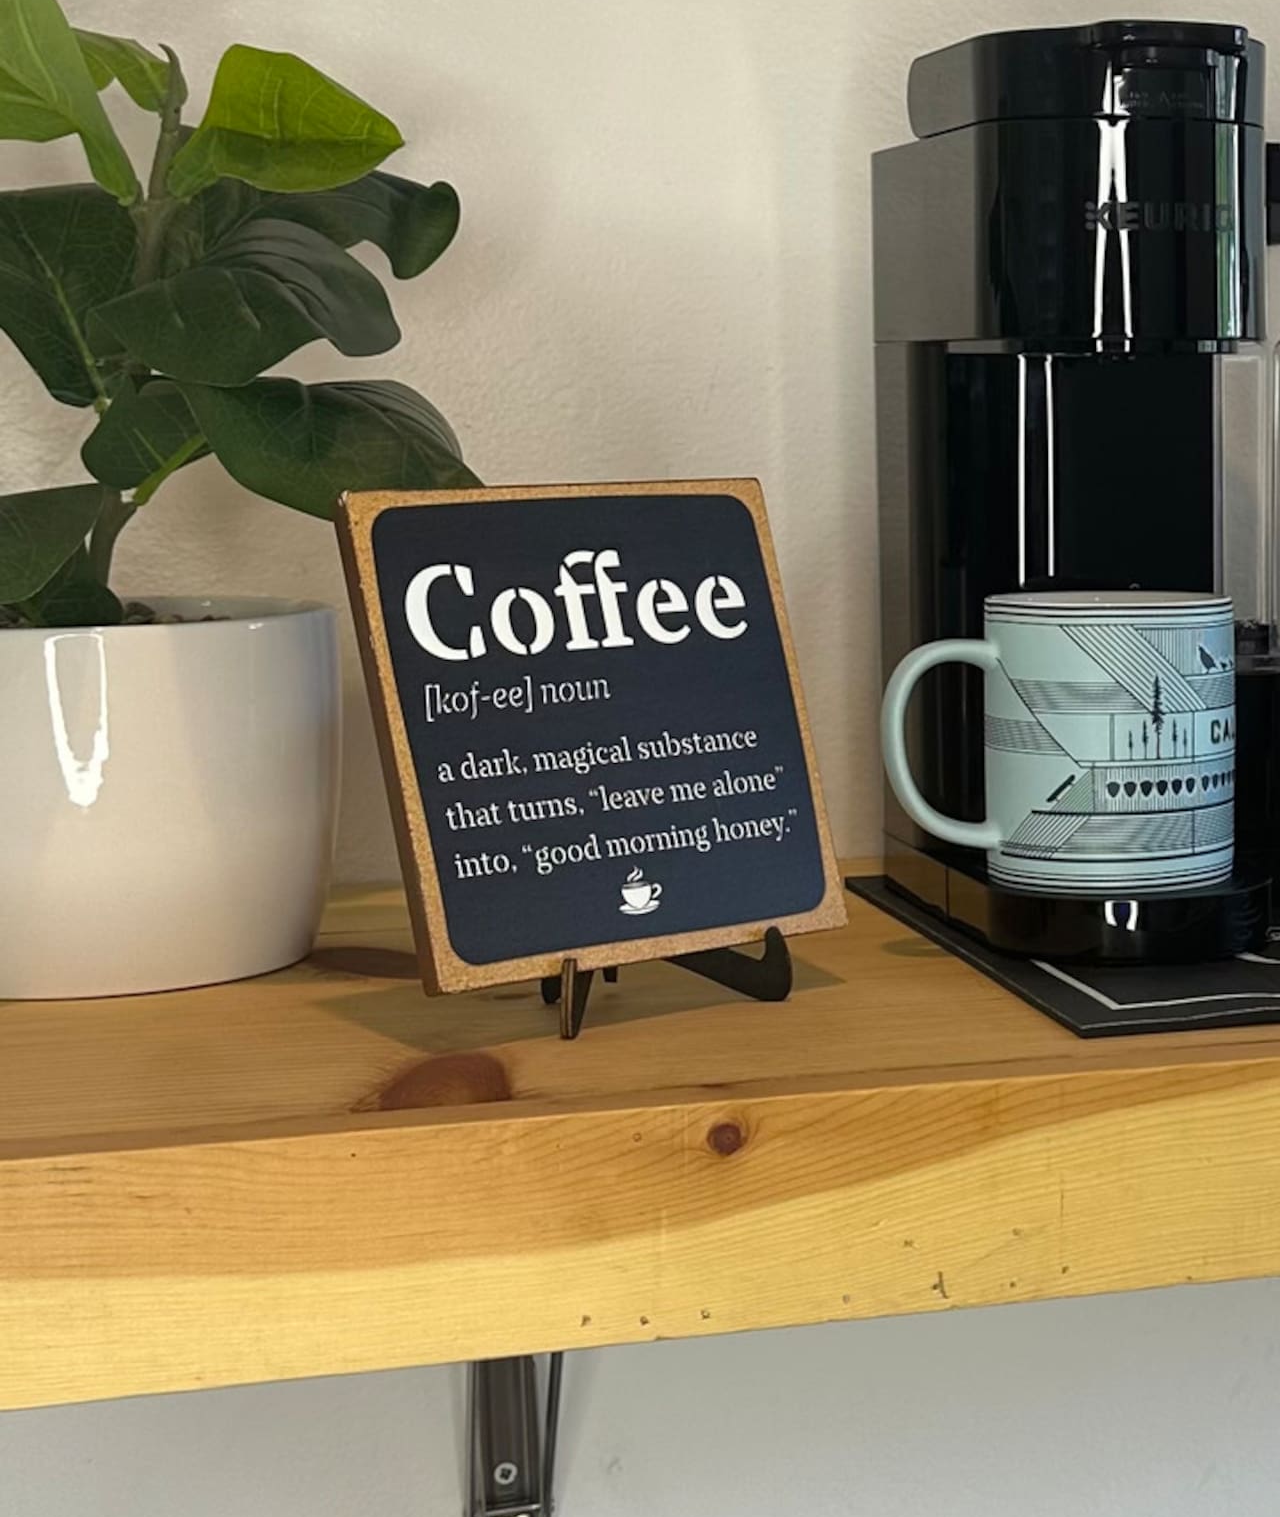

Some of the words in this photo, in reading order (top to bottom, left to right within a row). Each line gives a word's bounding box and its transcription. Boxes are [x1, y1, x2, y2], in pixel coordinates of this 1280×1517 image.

[1084, 201, 1233, 233] KEURIG
[405, 549, 748, 661] Coffee
[425, 675, 533, 722] [kof-ee]
[540, 678, 611, 705] noun
[437, 762, 456, 783] a
[460, 748, 528, 780] dark,
[532, 736, 632, 774] magical
[637, 730, 758, 760] substance
[445, 801, 503, 831] that
[507, 795, 585, 822] turns,
[669, 781, 707, 803] me
[454, 853, 518, 879] into,
[605, 824, 712, 853] morning
